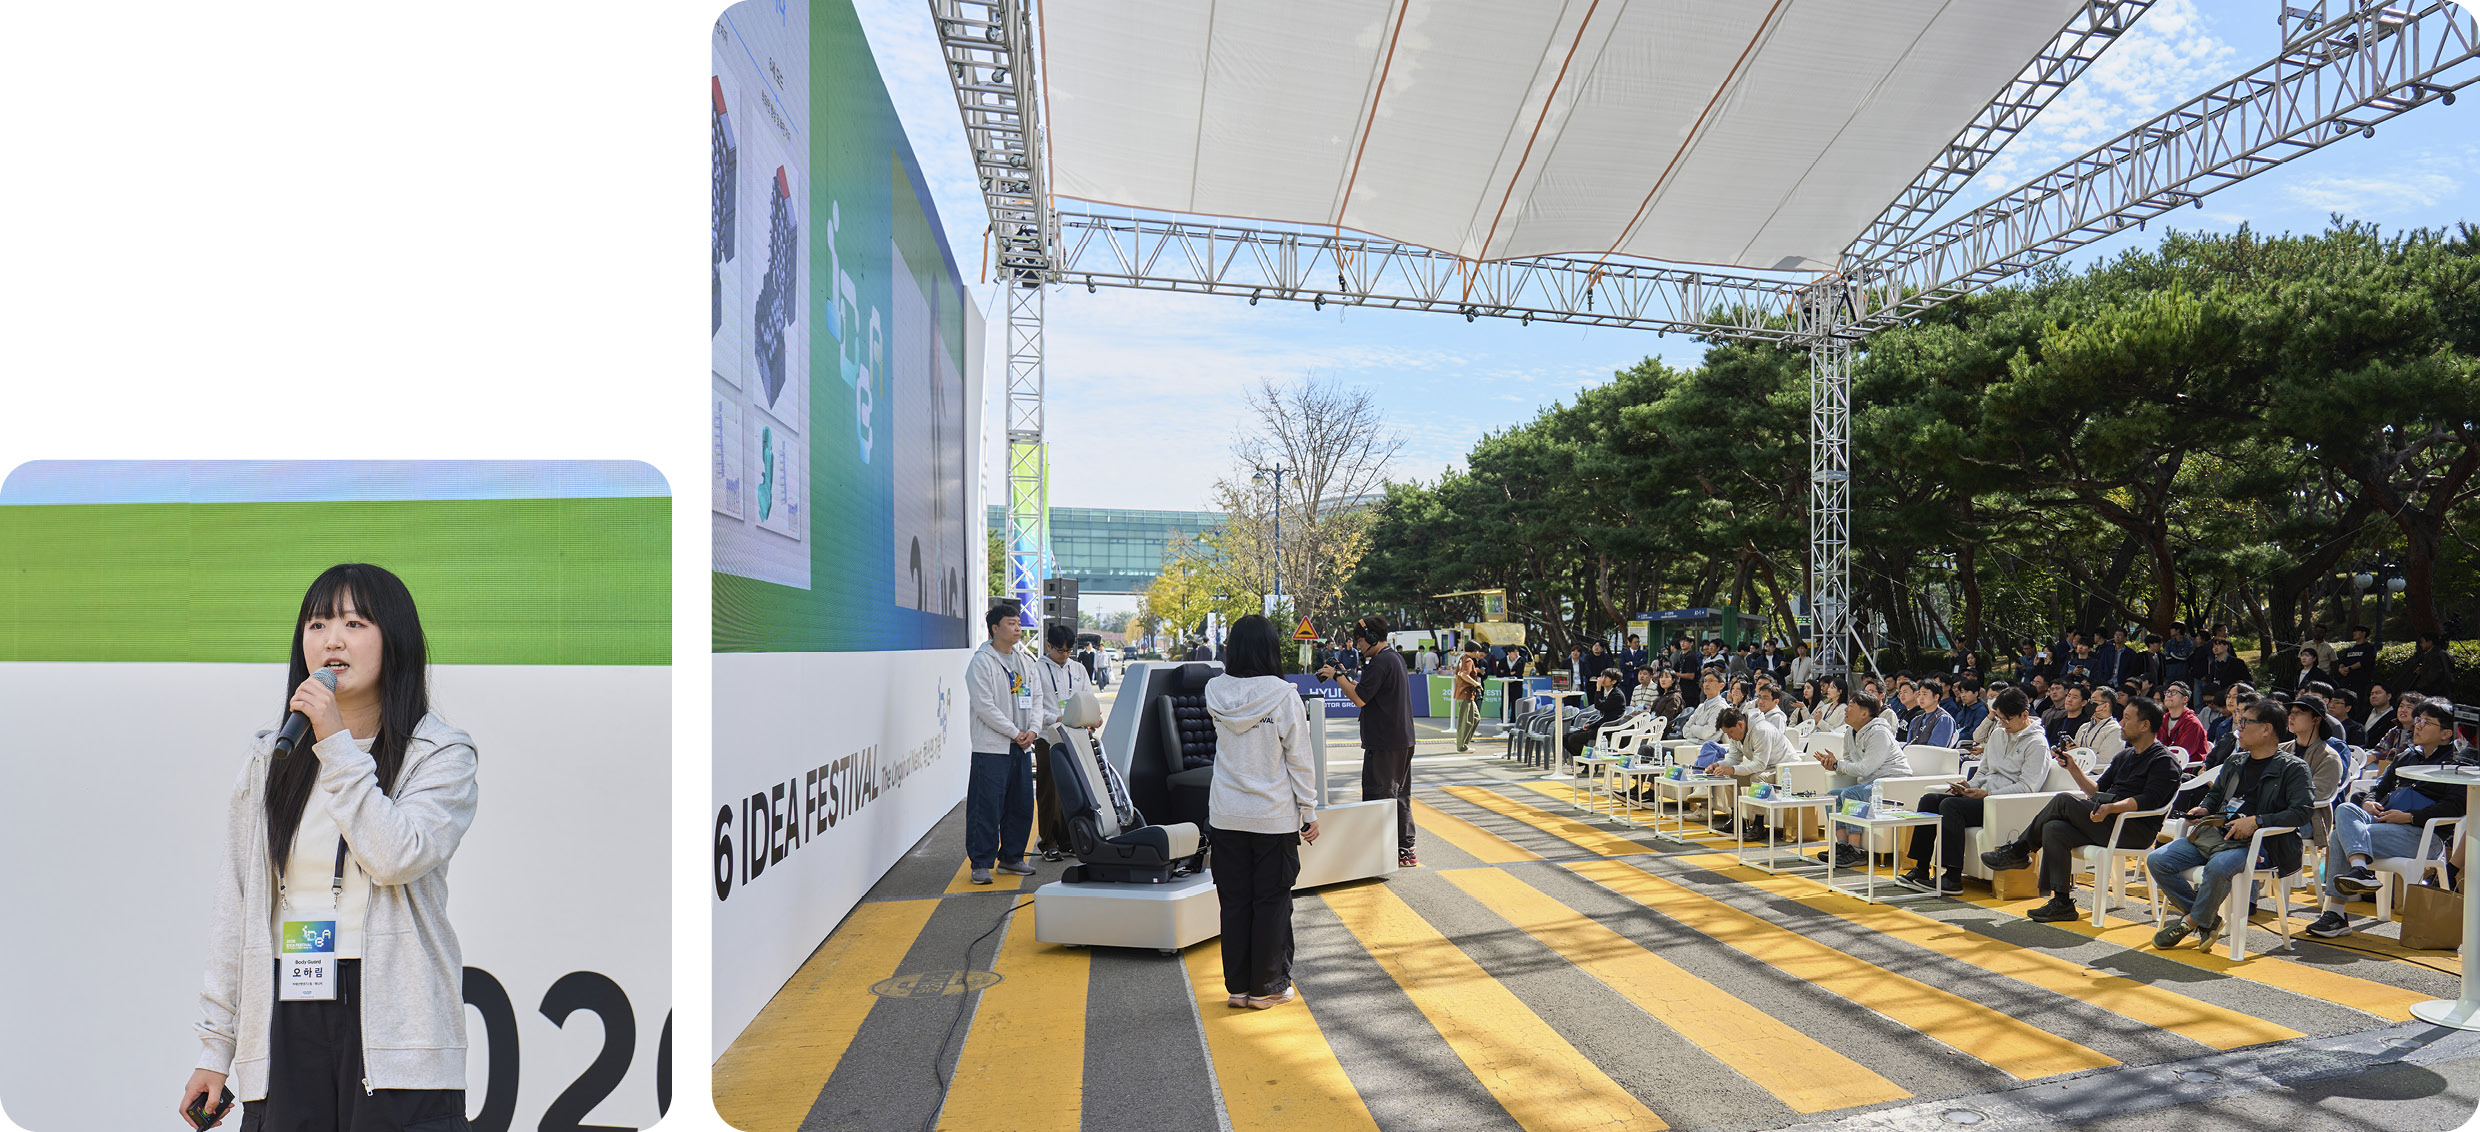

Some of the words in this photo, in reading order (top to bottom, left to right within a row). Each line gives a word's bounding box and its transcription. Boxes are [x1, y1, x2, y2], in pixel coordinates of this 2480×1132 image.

[714, 804, 734, 902] 6
[742, 777, 800, 887] IDEA
[804, 743, 880, 844] FESTIVAL
[881, 765, 892, 794] The
[892, 754, 906, 789] Origin
